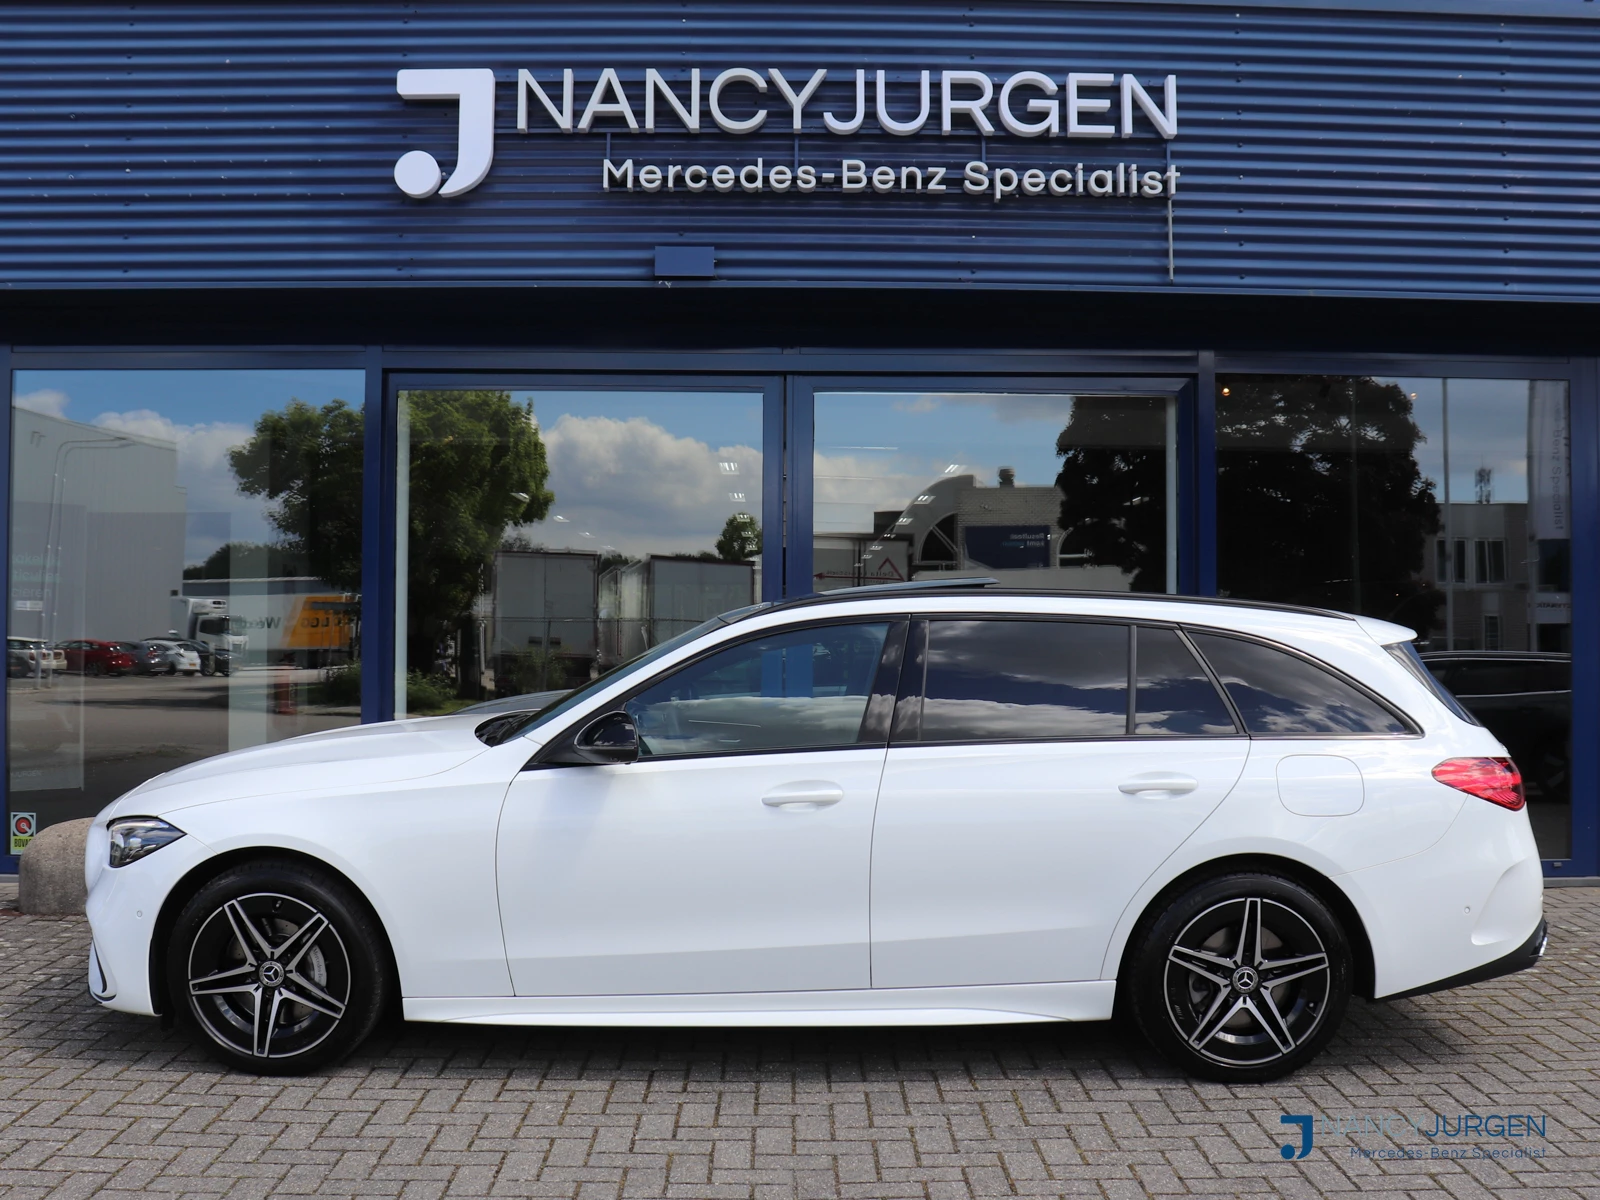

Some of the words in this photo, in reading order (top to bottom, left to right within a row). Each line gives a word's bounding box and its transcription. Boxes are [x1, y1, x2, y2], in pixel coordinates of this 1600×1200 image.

[516, 67, 1178, 139] NANCYJURGEN
[602, 157, 947, 194] Mercedes-Benz
[963, 160, 1181, 203] Specialist
[14, 838, 32, 848] BOVA
